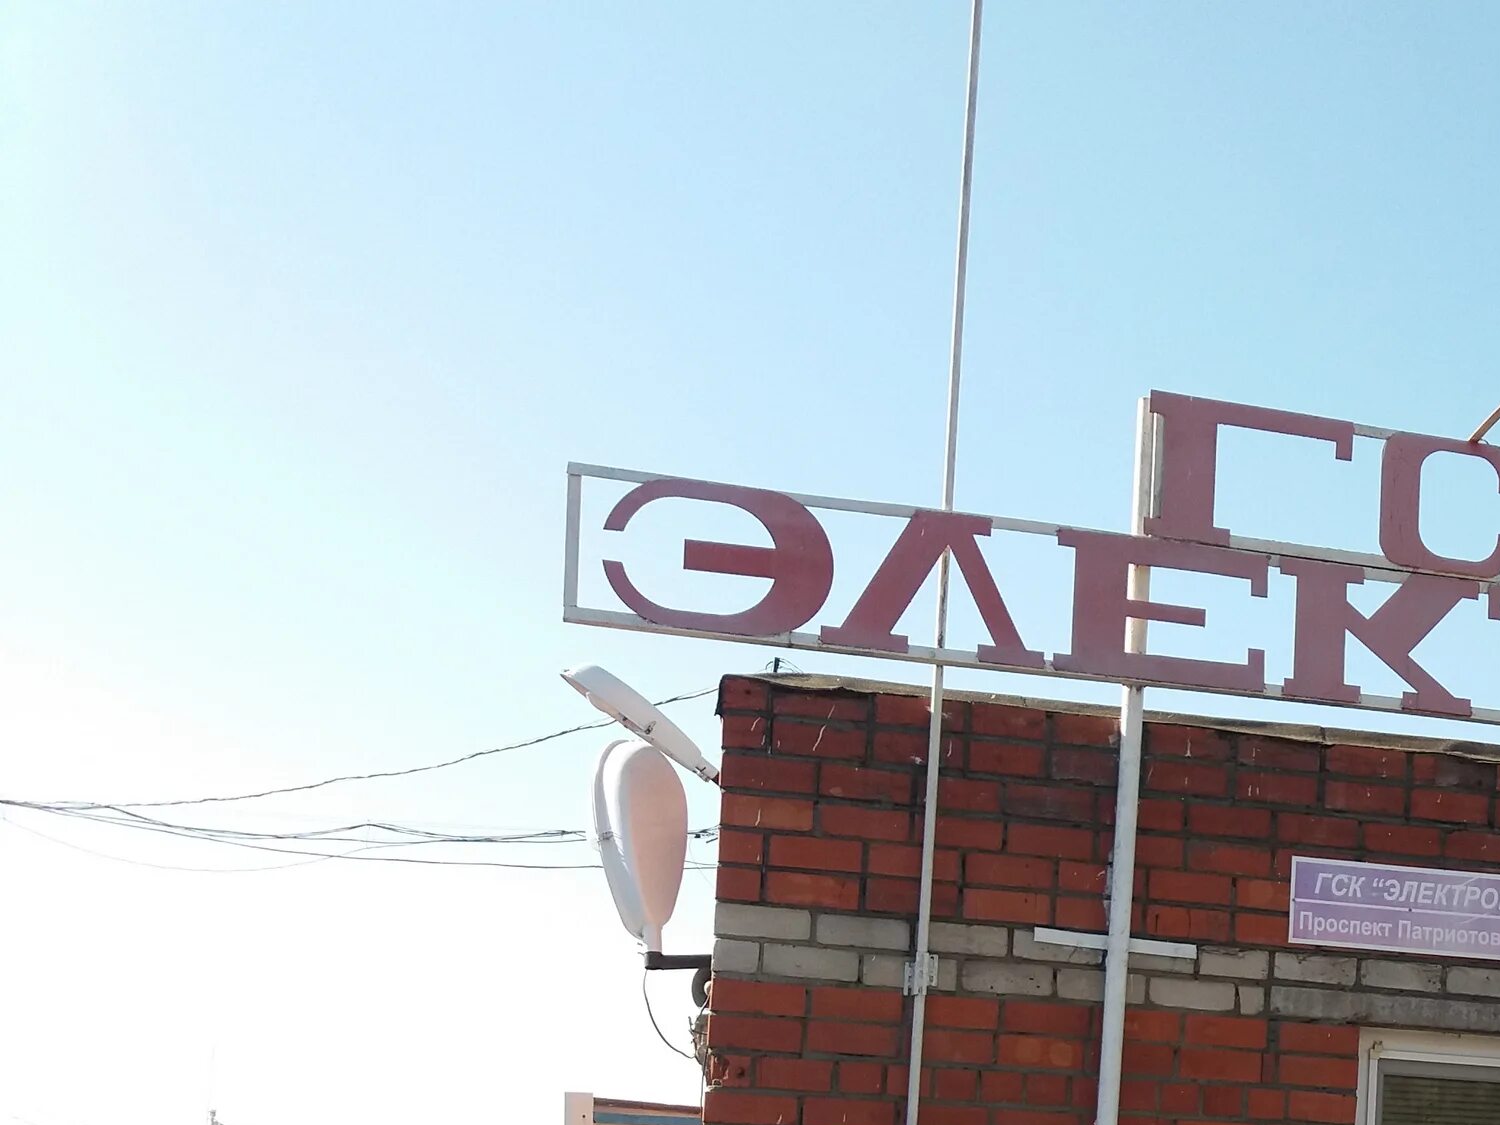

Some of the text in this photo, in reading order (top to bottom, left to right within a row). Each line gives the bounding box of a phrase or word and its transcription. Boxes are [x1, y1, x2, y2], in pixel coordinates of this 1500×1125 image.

[1314, 873, 1366, 898] ГСК
[1299, 911, 1393, 936] Проспект
[1398, 920, 1500, 946] Патриотов
